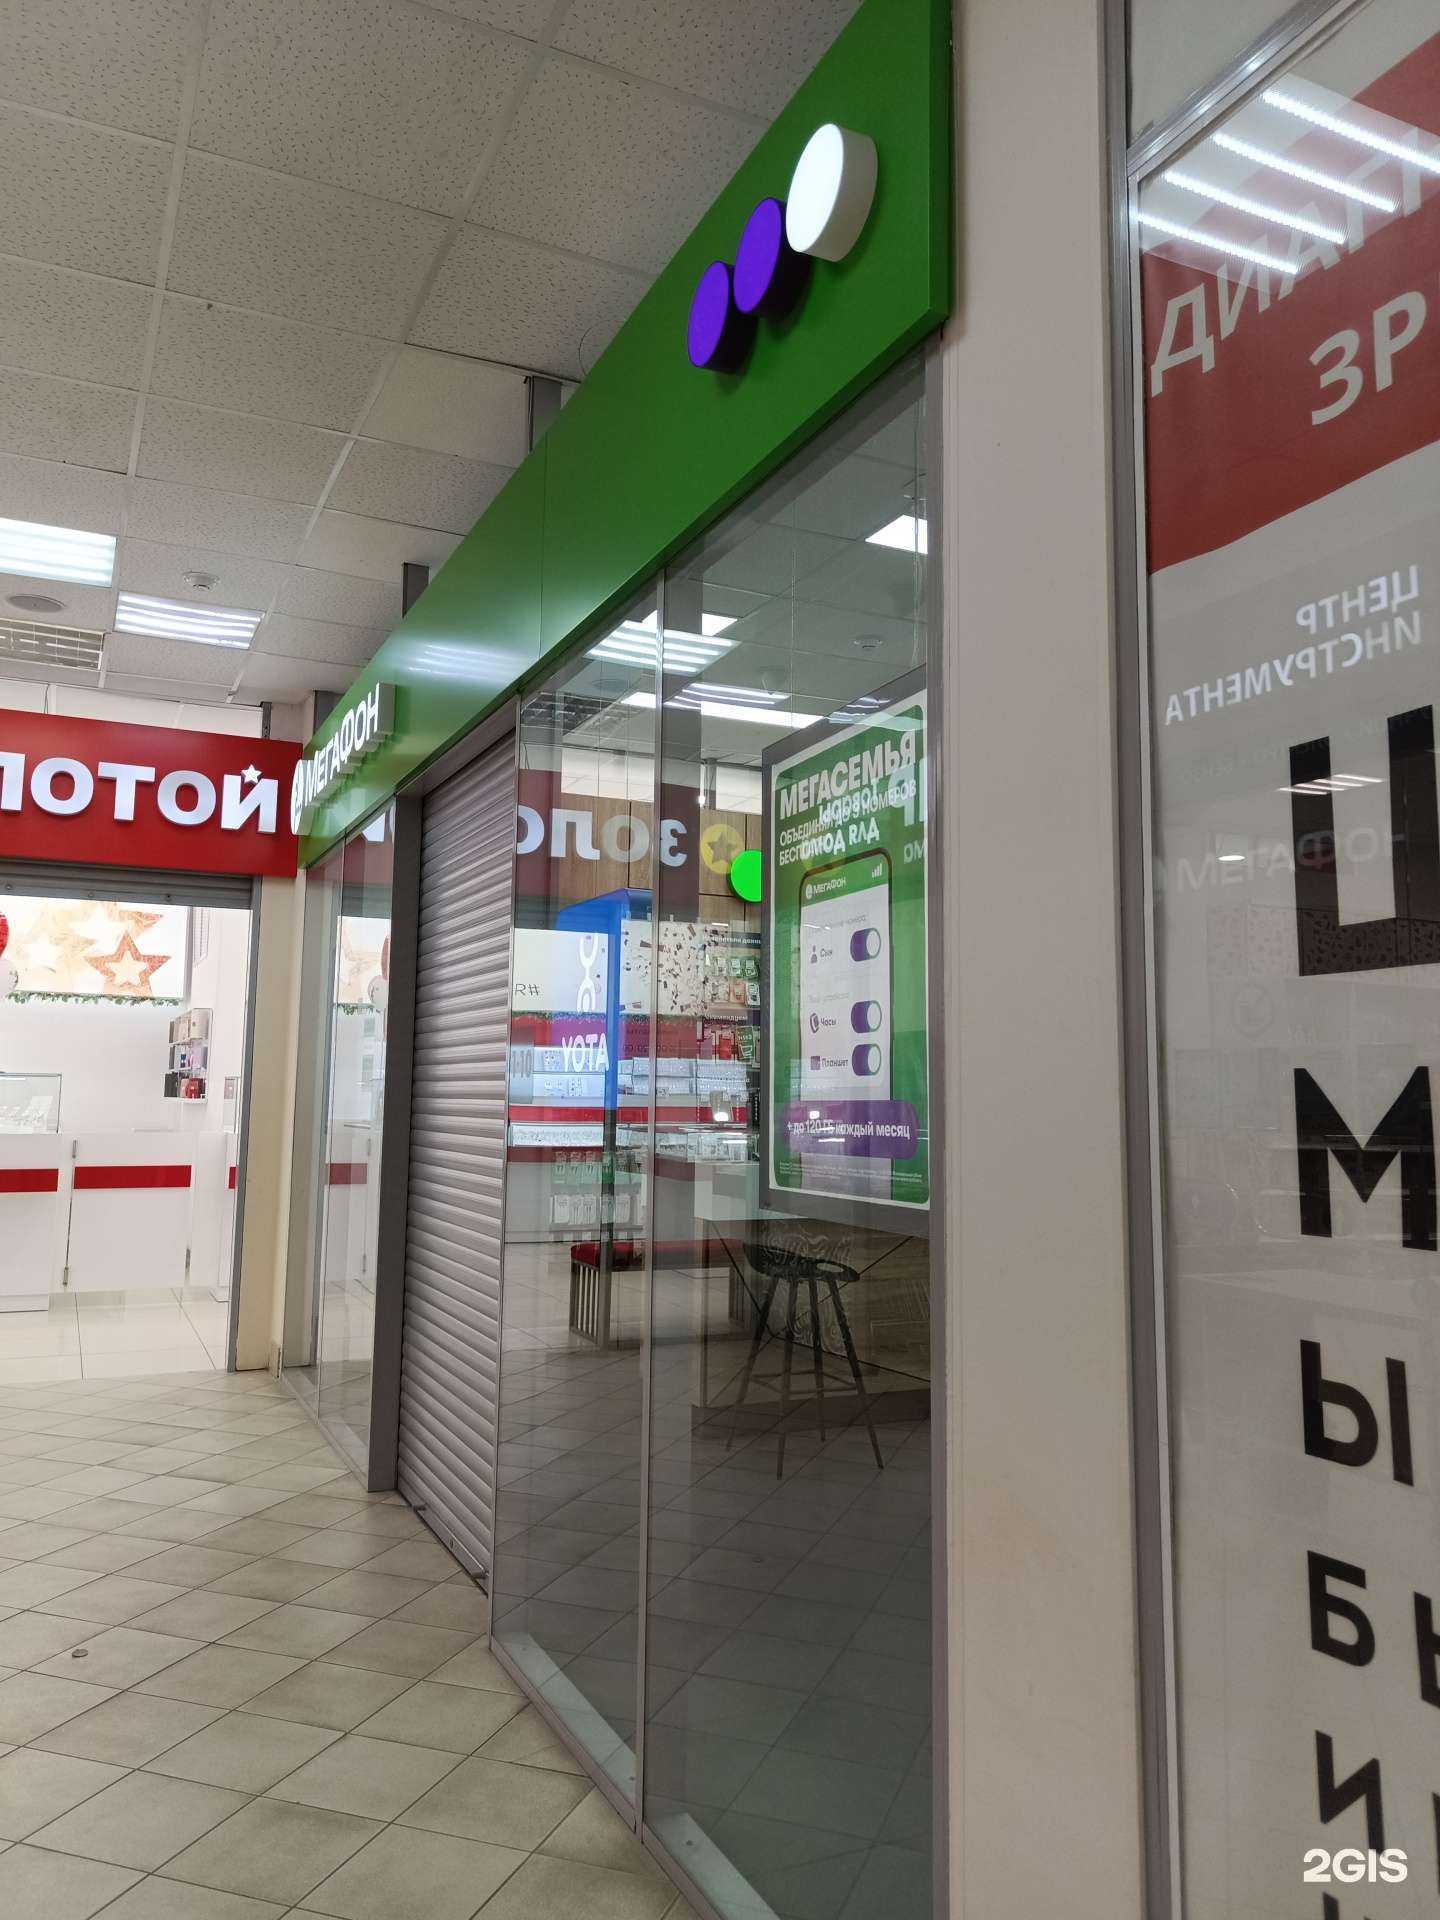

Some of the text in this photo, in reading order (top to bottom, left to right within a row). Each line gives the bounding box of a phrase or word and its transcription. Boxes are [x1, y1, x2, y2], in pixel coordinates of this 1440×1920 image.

[304, 683, 380, 807] МЕГАФОН
[779, 730, 916, 820] МЕГАСЕМЬЯ
[813, 877, 847, 896] МЕГАФОН
[820, 1018, 837, 1027] Часы
[561, 1032, 610, 1072] YOTA
[822, 1058, 849, 1068] Планшет
[835, 1122, 875, 1138] каждый
[875, 1123, 911, 1140] месяц
[1306, 1550, 1376, 1668] Б
